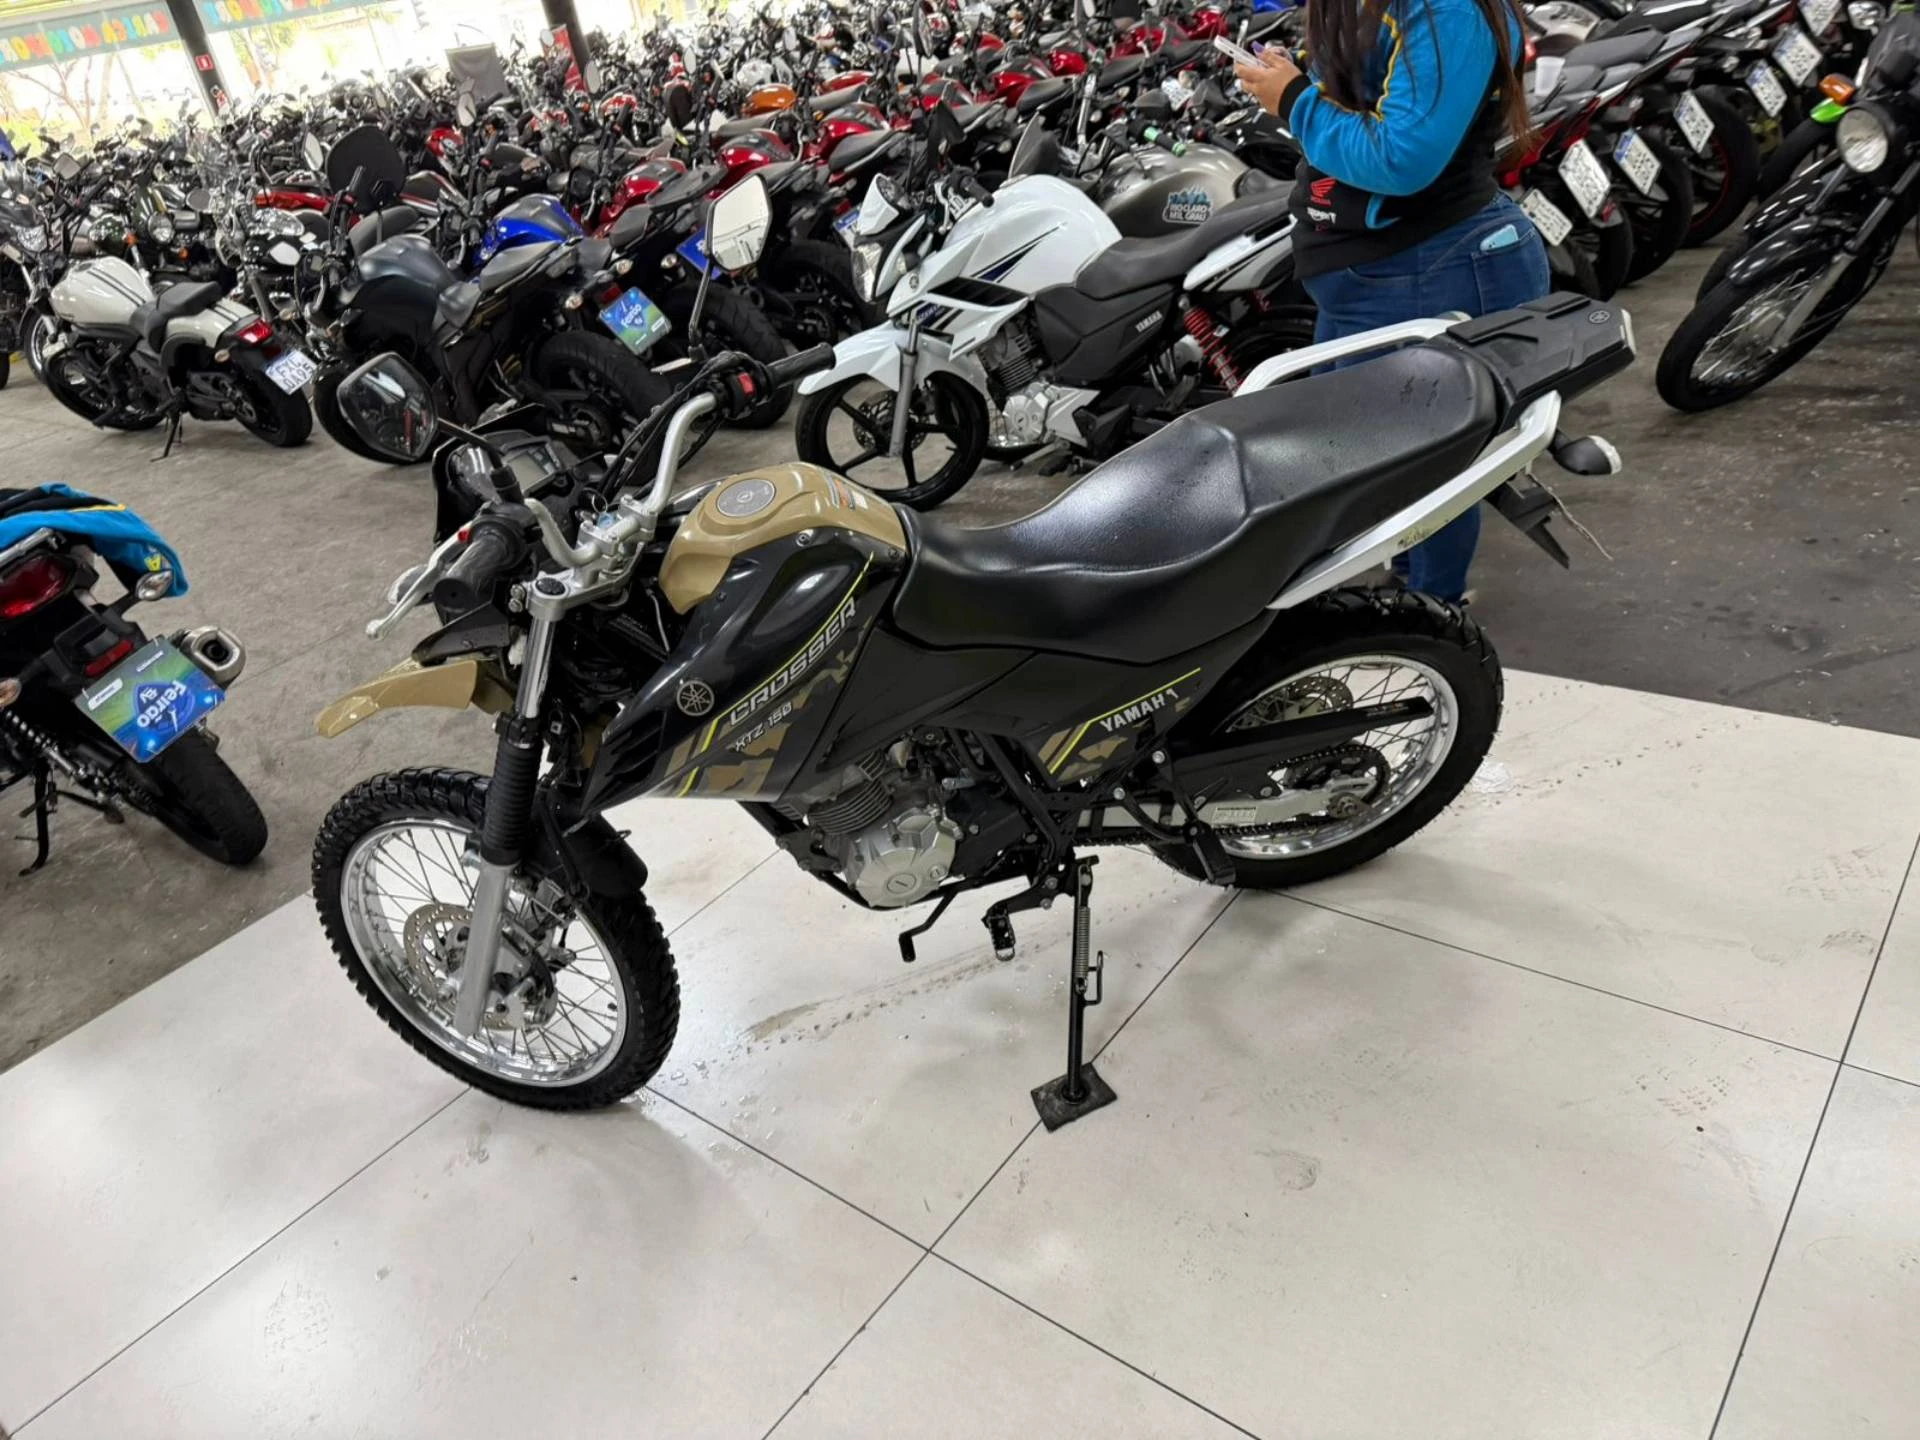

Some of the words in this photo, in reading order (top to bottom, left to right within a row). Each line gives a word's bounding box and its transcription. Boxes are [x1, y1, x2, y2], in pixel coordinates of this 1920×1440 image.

[729, 596, 857, 727] CROSSER
[136, 680, 186, 728] Feirão
[734, 722, 766, 753] XTZ
[767, 702, 792, 730] 150
